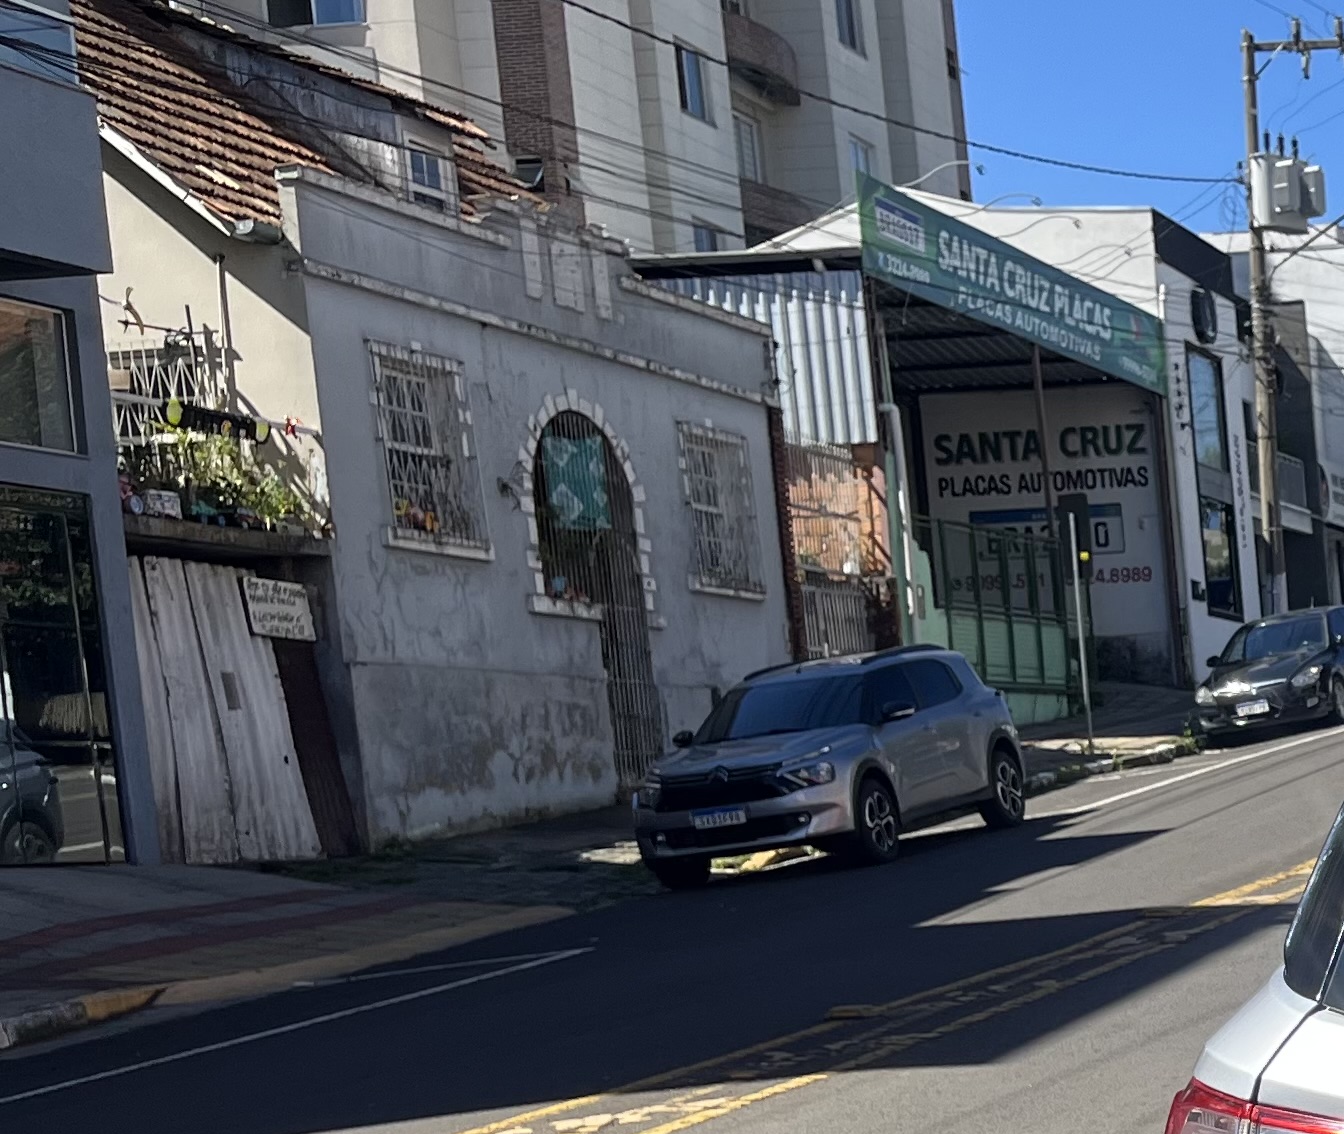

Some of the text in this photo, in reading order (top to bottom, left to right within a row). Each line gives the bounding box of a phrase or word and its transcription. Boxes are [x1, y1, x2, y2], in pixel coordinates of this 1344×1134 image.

[937, 229, 1112, 341] SANTA CRUZ PLACAS
[957, 285, 1102, 362] PLACAS AUTOMOTIVAS
[933, 423, 1148, 467] SANTA CRUZ
[938, 473, 1012, 499] PLACAS
